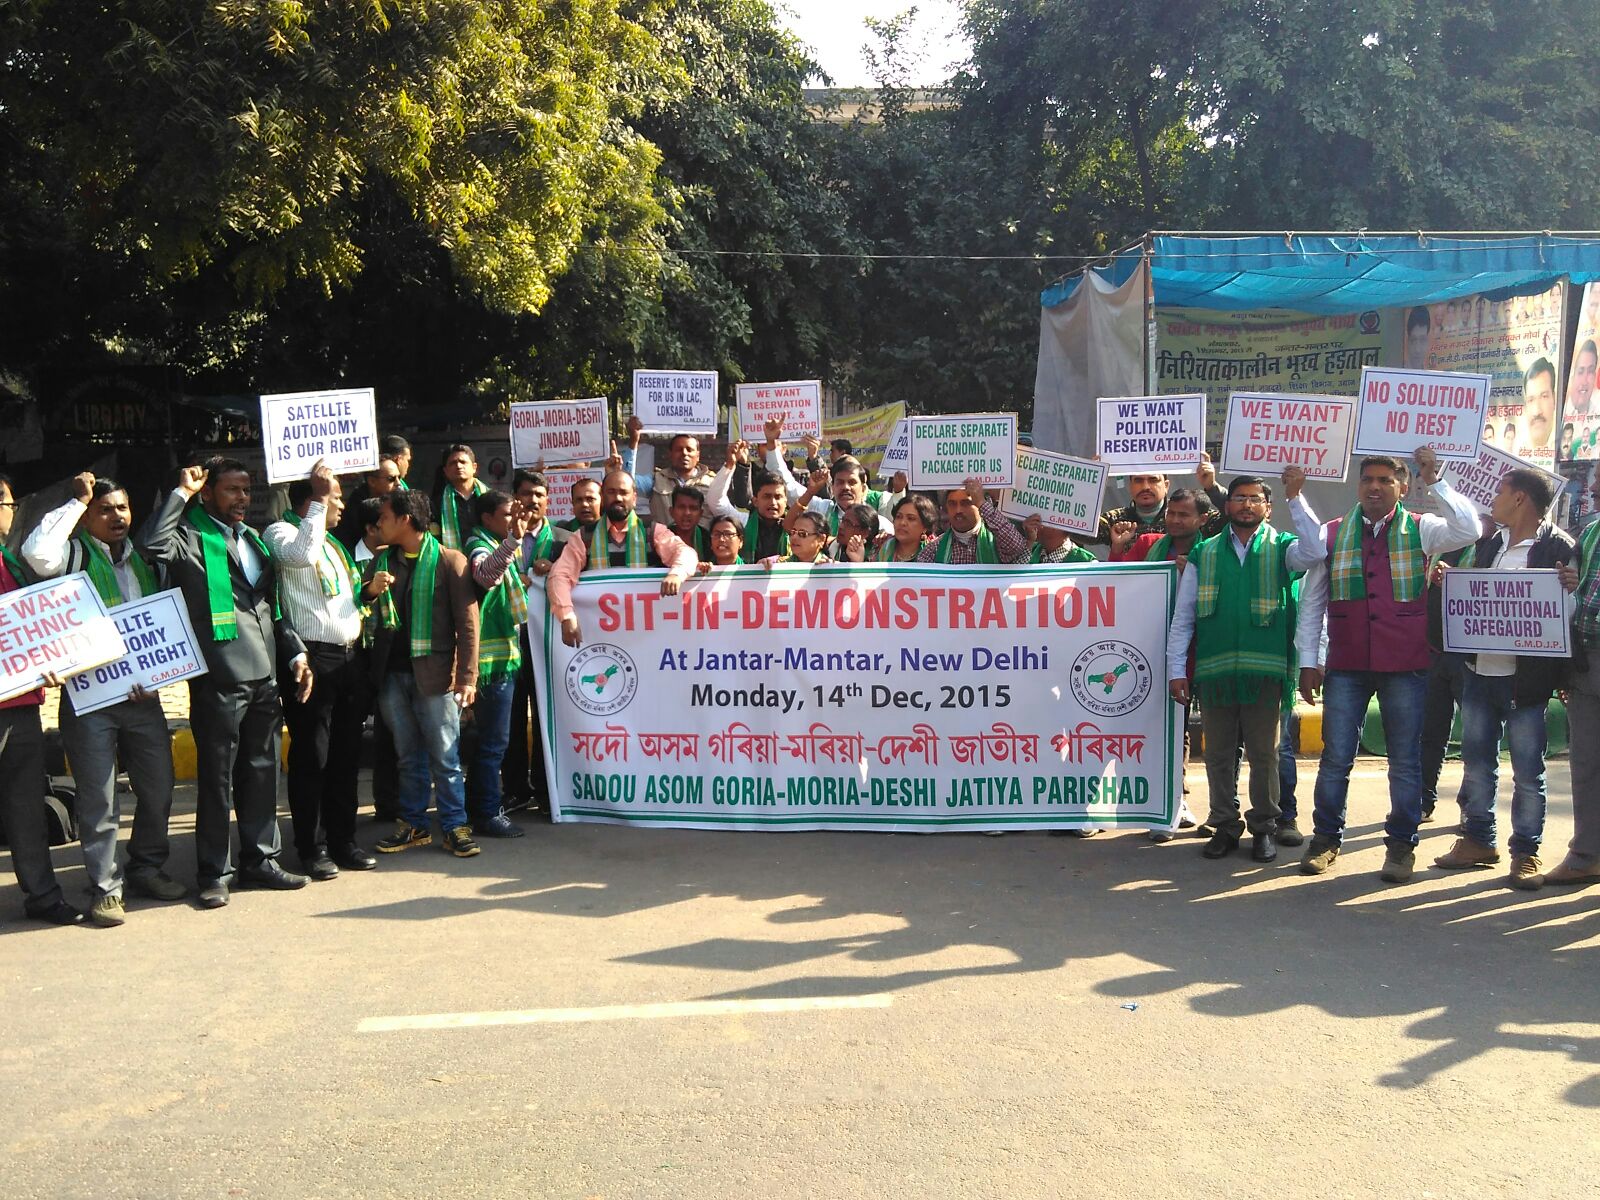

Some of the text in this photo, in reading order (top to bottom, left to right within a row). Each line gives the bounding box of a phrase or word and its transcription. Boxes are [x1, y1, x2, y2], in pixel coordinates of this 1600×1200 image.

[1157, 346, 1382, 381] निश्चितकालीन भूख हड़ताल
[639, 377, 712, 389] RESERVE 10% SEATS
[756, 388, 801, 398] WE WANT
[648, 391, 702, 404] FOR US IN LAC,
[747, 399, 811, 410] RESERVATION
[1367, 381, 1480, 414] NO SOLUTION,
[74, 403, 146, 431] LIBRARY
[287, 401, 352, 422] SATELLTE
[513, 406, 601, 429] GORIA-MORIA-DESHI
[657, 405, 693, 417] LOKSABHA
[754, 412, 764, 420] IN
[798, 411, 806, 419] &
[1118, 402, 1184, 418] WE WANT
[1241, 400, 1272, 420] WE
[1278, 402, 1343, 423] WANT
[283, 419, 358, 441] AUTONOMY
[782, 420, 817, 431] SECTOR
[916, 424, 957, 439] DECLARE
[960, 422, 1008, 438] SEPARATE
[1116, 419, 1186, 436] POLITICAL
[1250, 423, 1328, 444] ETHNIC
[1386, 411, 1457, 437] NO REST
[278, 436, 370, 461] IS OUR RIGHT
[538, 430, 581, 450] JINDABAD
[936, 441, 987, 456] ECONOMIC
[1104, 436, 1198, 454] RESERVATION
[1427, 441, 1473, 453] G.M.D.J.P.
[1154, 453, 1198, 462] G.M.D.J.P.
[1243, 443, 1328, 466] IDENITY
[1477, 451, 1498, 472] WE
[921, 458, 1002, 474] PACKAGE FOR US
[1052, 461, 1099, 484] SEPARATE
[1027, 474, 1075, 498] ECONOMIC
[1011, 490, 1087, 518] PACKAGE FOR US
[1049, 514, 1089, 530] G.M.D.J.P.
[1470, 580, 1533, 598] WE WANT
[11, 590, 82, 620] WANT
[598, 586, 1116, 633] SIT-IN-DEMONSTRATION
[1448, 599, 1561, 619] CONSTITUTIONAL
[0, 607, 83, 652] ETHNIC
[1464, 618, 1543, 638] SAFEGAURD
[1514, 639, 1562, 649] G.M.D.J.P.
[71, 640, 188, 693] IS OUR RIGHT
[659, 645, 1048, 674] At Jantar-Mantar, New Delhi
[151, 662, 198, 684] G.M.D.J.P.
[691, 682, 1011, 714] Monday, 14th Dec, 2015
[571, 720, 631, 763] সদৌ
[637, 731, 700, 765] অসম
[948, 721, 1041, 766] জাতীয়
[572, 771, 1149, 808] SADOU ASOM GORIA-MORIA-DESHI JATIYA PARISHAD
